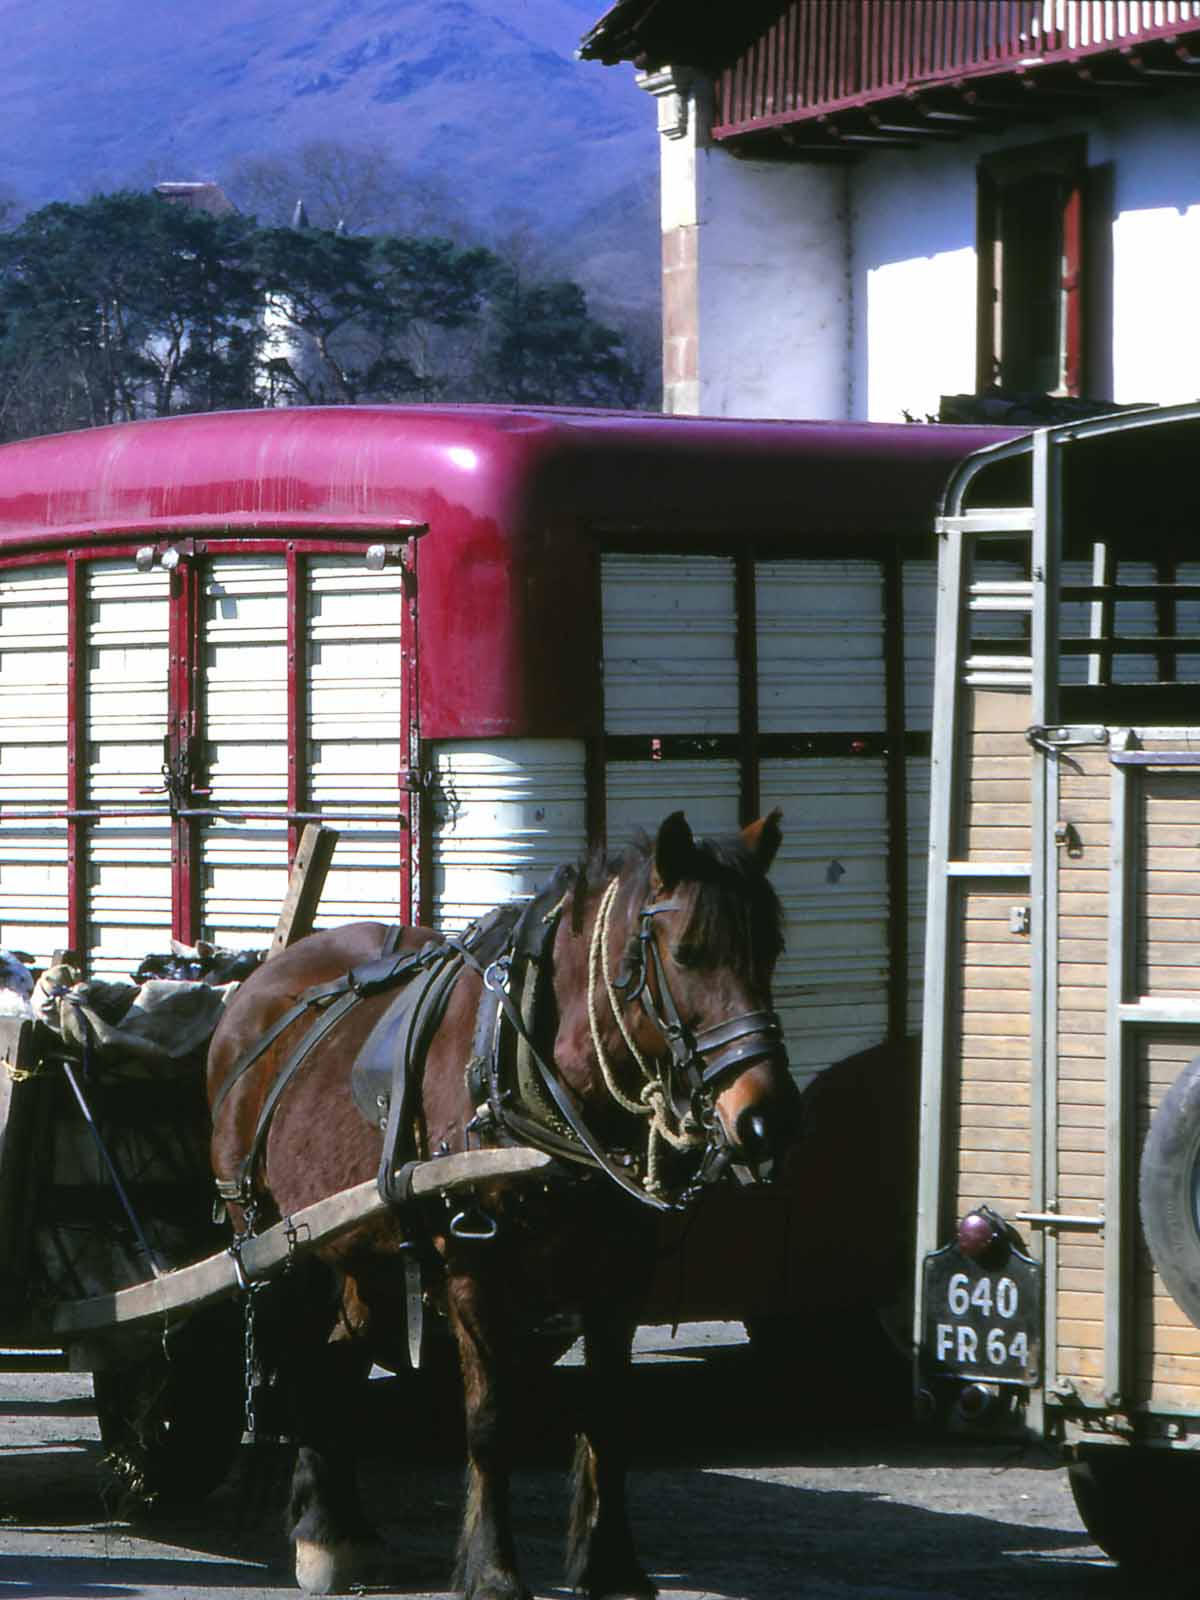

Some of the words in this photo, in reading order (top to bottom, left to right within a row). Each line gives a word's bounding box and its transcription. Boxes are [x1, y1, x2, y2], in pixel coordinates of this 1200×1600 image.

[948, 1273, 1019, 1319] 640
[937, 1324, 978, 1363] FR
[986, 1328, 1029, 1367] 64
